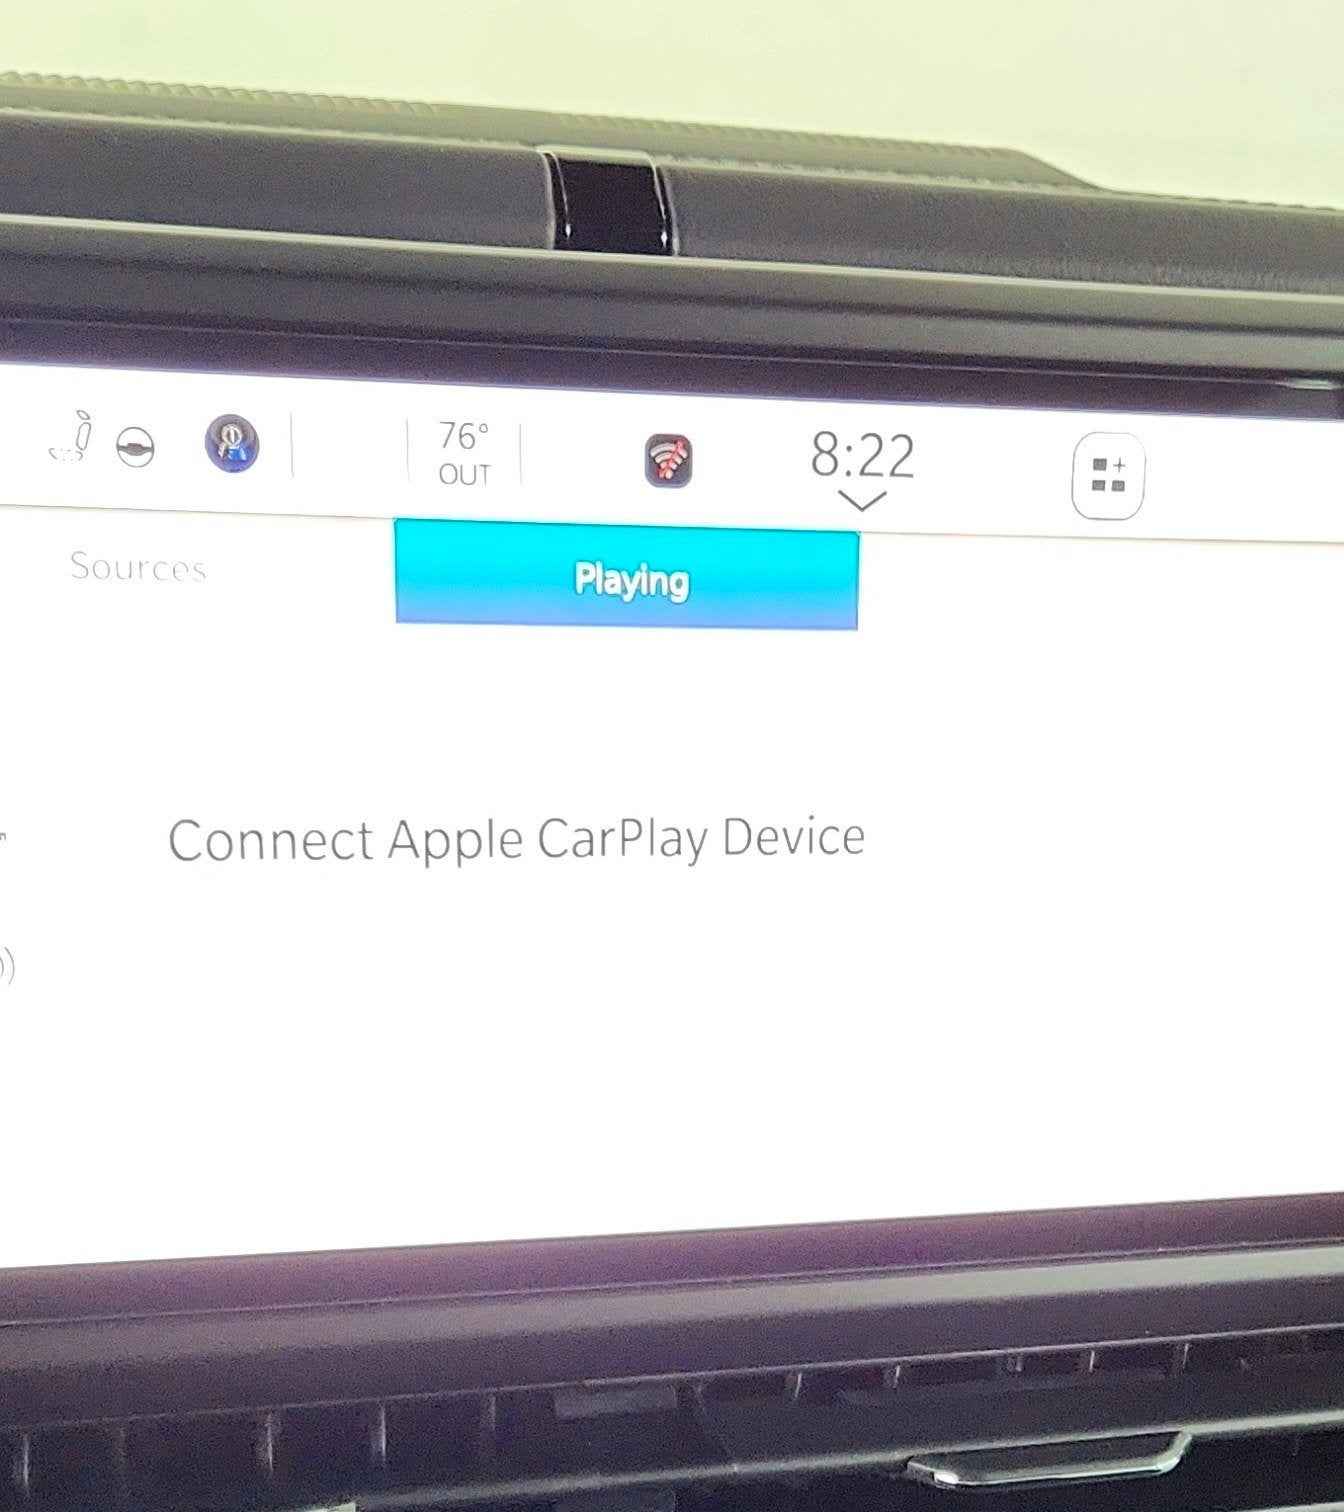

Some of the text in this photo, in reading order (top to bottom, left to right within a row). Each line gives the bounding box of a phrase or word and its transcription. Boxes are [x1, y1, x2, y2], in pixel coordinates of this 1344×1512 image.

[438, 421, 490, 451] 76°
[812, 432, 916, 479] 8:22
[439, 464, 491, 487] OUT
[69, 550, 208, 583] Sources
[574, 560, 691, 604] Playing
[169, 815, 866, 868] Connect Apple CarPlay Device
